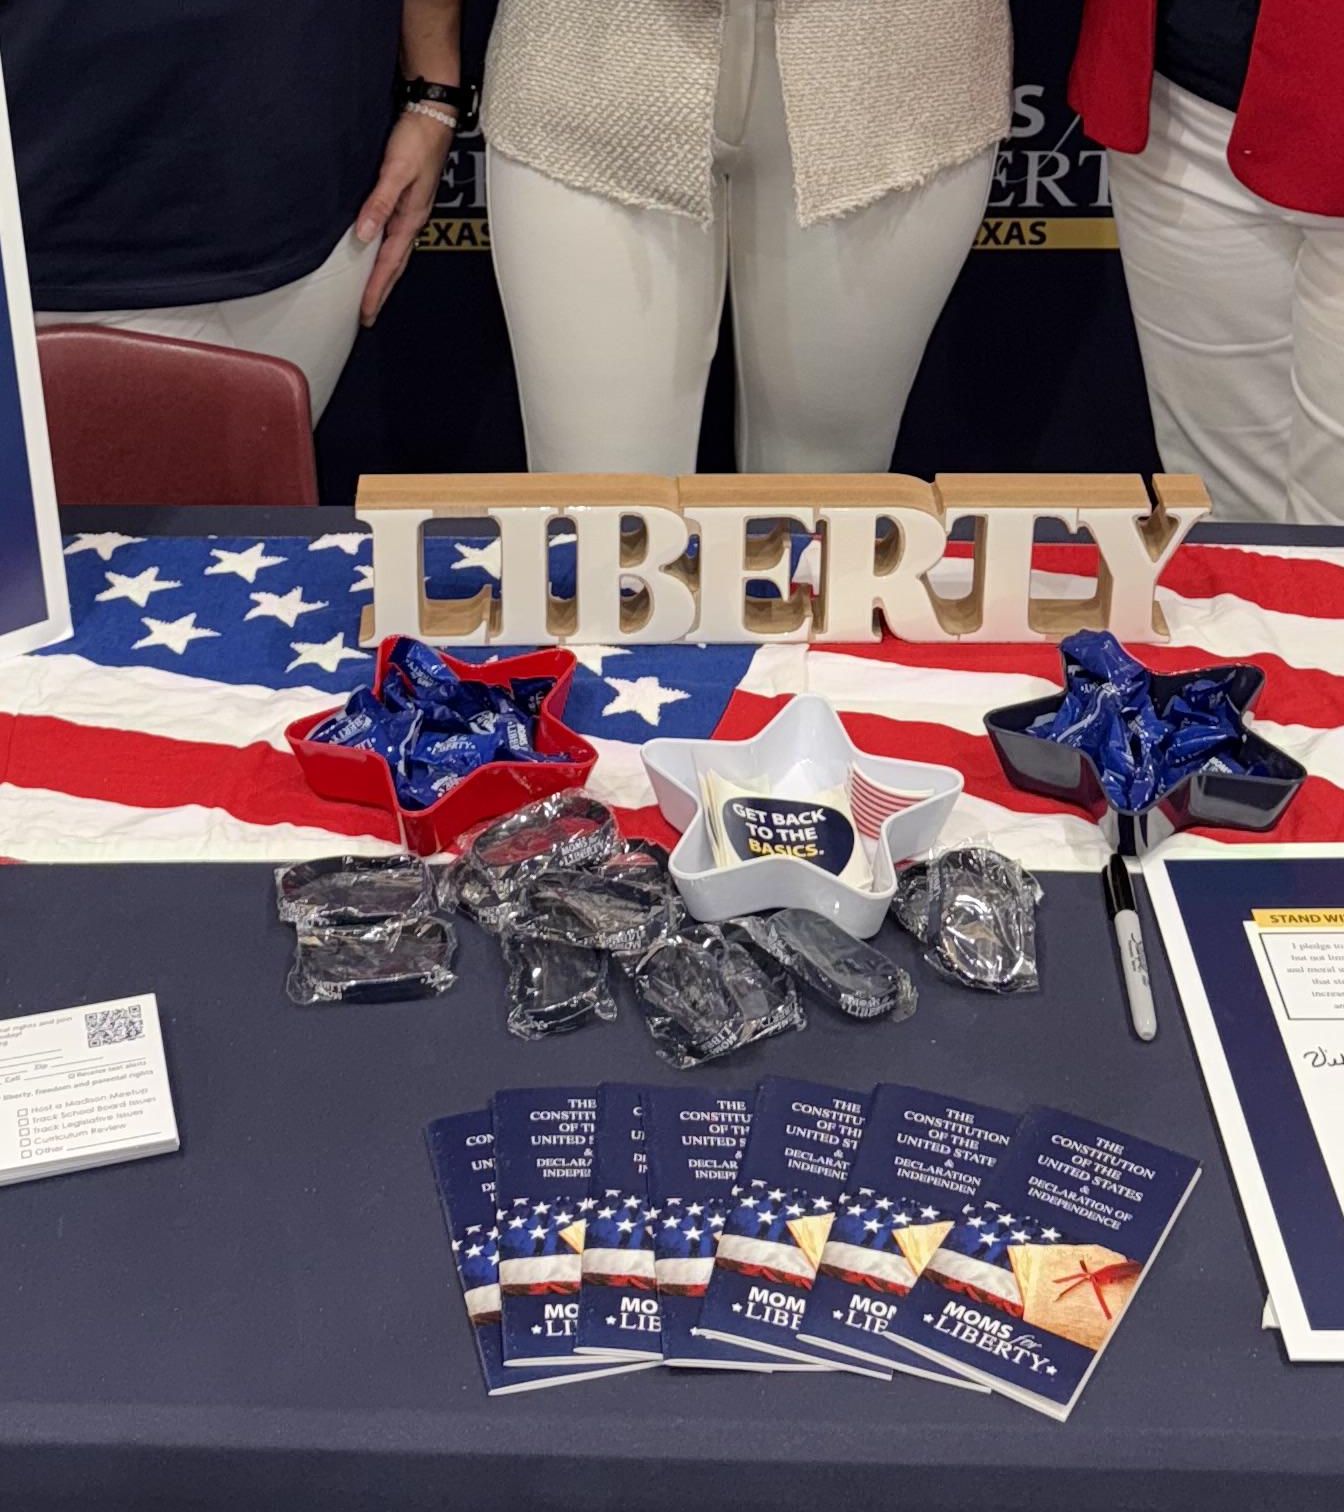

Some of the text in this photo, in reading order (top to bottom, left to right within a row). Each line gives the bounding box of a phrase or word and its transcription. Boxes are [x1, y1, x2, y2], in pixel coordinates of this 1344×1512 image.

[973, 221, 1047, 245] XAS
[354, 502, 1211, 647] LIBERTY
[732, 803, 827, 827] GET BACK
[745, 822, 818, 842] TO THE
[749, 839, 825, 858] BASICS.
[1270, 914, 1322, 925] STAND
[32, 1096, 156, 1124] Track School Board Issues
[65, 1094, 106, 1108] Madison
[904, 1110, 1010, 1146] CONSTITUTION
[946, 1108, 974, 1124] THE
[34, 1123, 127, 1144] Curriculum Review
[928, 1128, 980, 1150] OF THE
[1096, 1136, 1125, 1155] THE
[35, 1145, 64, 1156] Other
[896, 1133, 997, 1168] UNITED STATE
[944, 1158, 954, 1168] &
[1051, 1134, 1156, 1180] CONSTITUTION
[894, 1156, 982, 1186] DECLARATION
[1037, 1154, 1144, 1202] UNITED STATES
[1071, 1153, 1122, 1180] OF THE
[896, 1168, 977, 1196] INDEPENDEN
[1079, 1185, 1090, 1195] &
[1027, 1187, 1121, 1230] INDEPENDENCE
[1028, 1176, 1134, 1222] DECLARATION OF
[748, 1286, 805, 1314] MOM
[943, 1300, 1042, 1350] MOMS for
[933, 1314, 1050, 1374] LIBERTY
